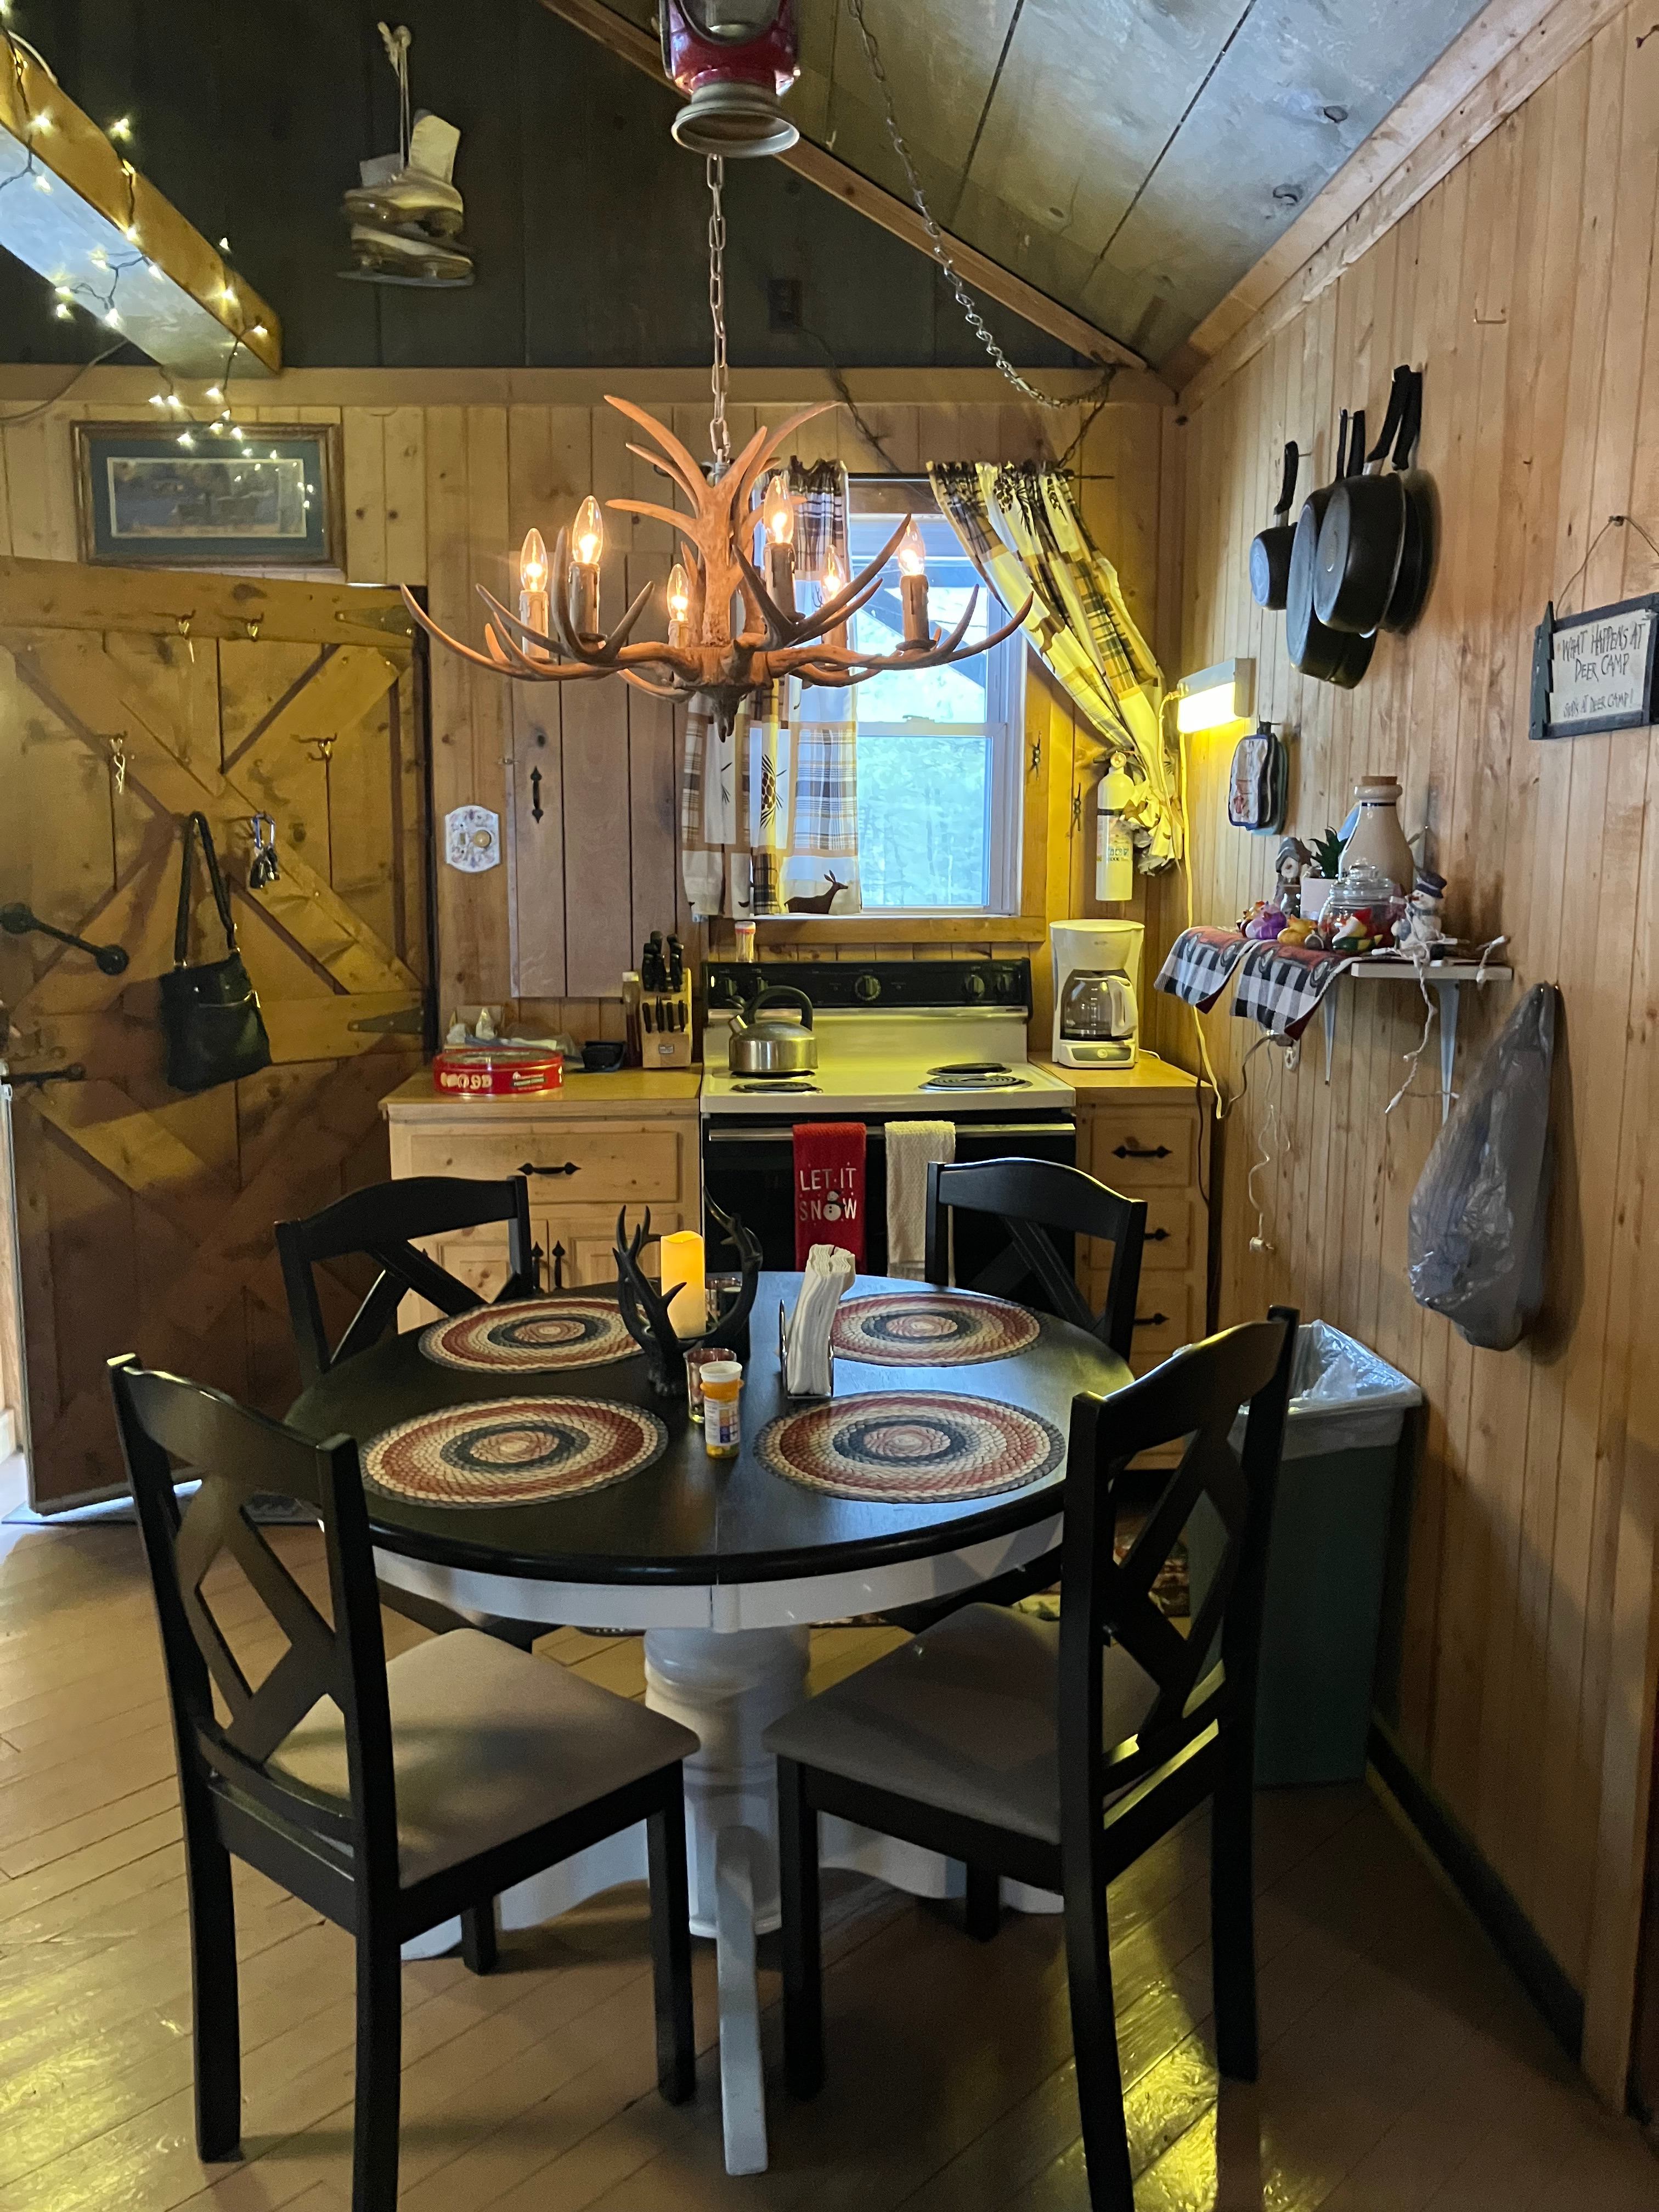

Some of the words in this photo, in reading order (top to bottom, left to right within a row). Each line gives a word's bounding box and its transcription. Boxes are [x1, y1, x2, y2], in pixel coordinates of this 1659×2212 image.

[1562, 630, 1588, 662] WHAT
[1591, 624, 1628, 656] HAPPENS
[1630, 622, 1646, 650] AT
[1575, 658, 1599, 682] DEER
[1601, 653, 1630, 677] CAMP
[800, 1169, 833, 1191] LET
[840, 1167, 857, 1188] IT
[799, 1197, 857, 1221] SNOW
